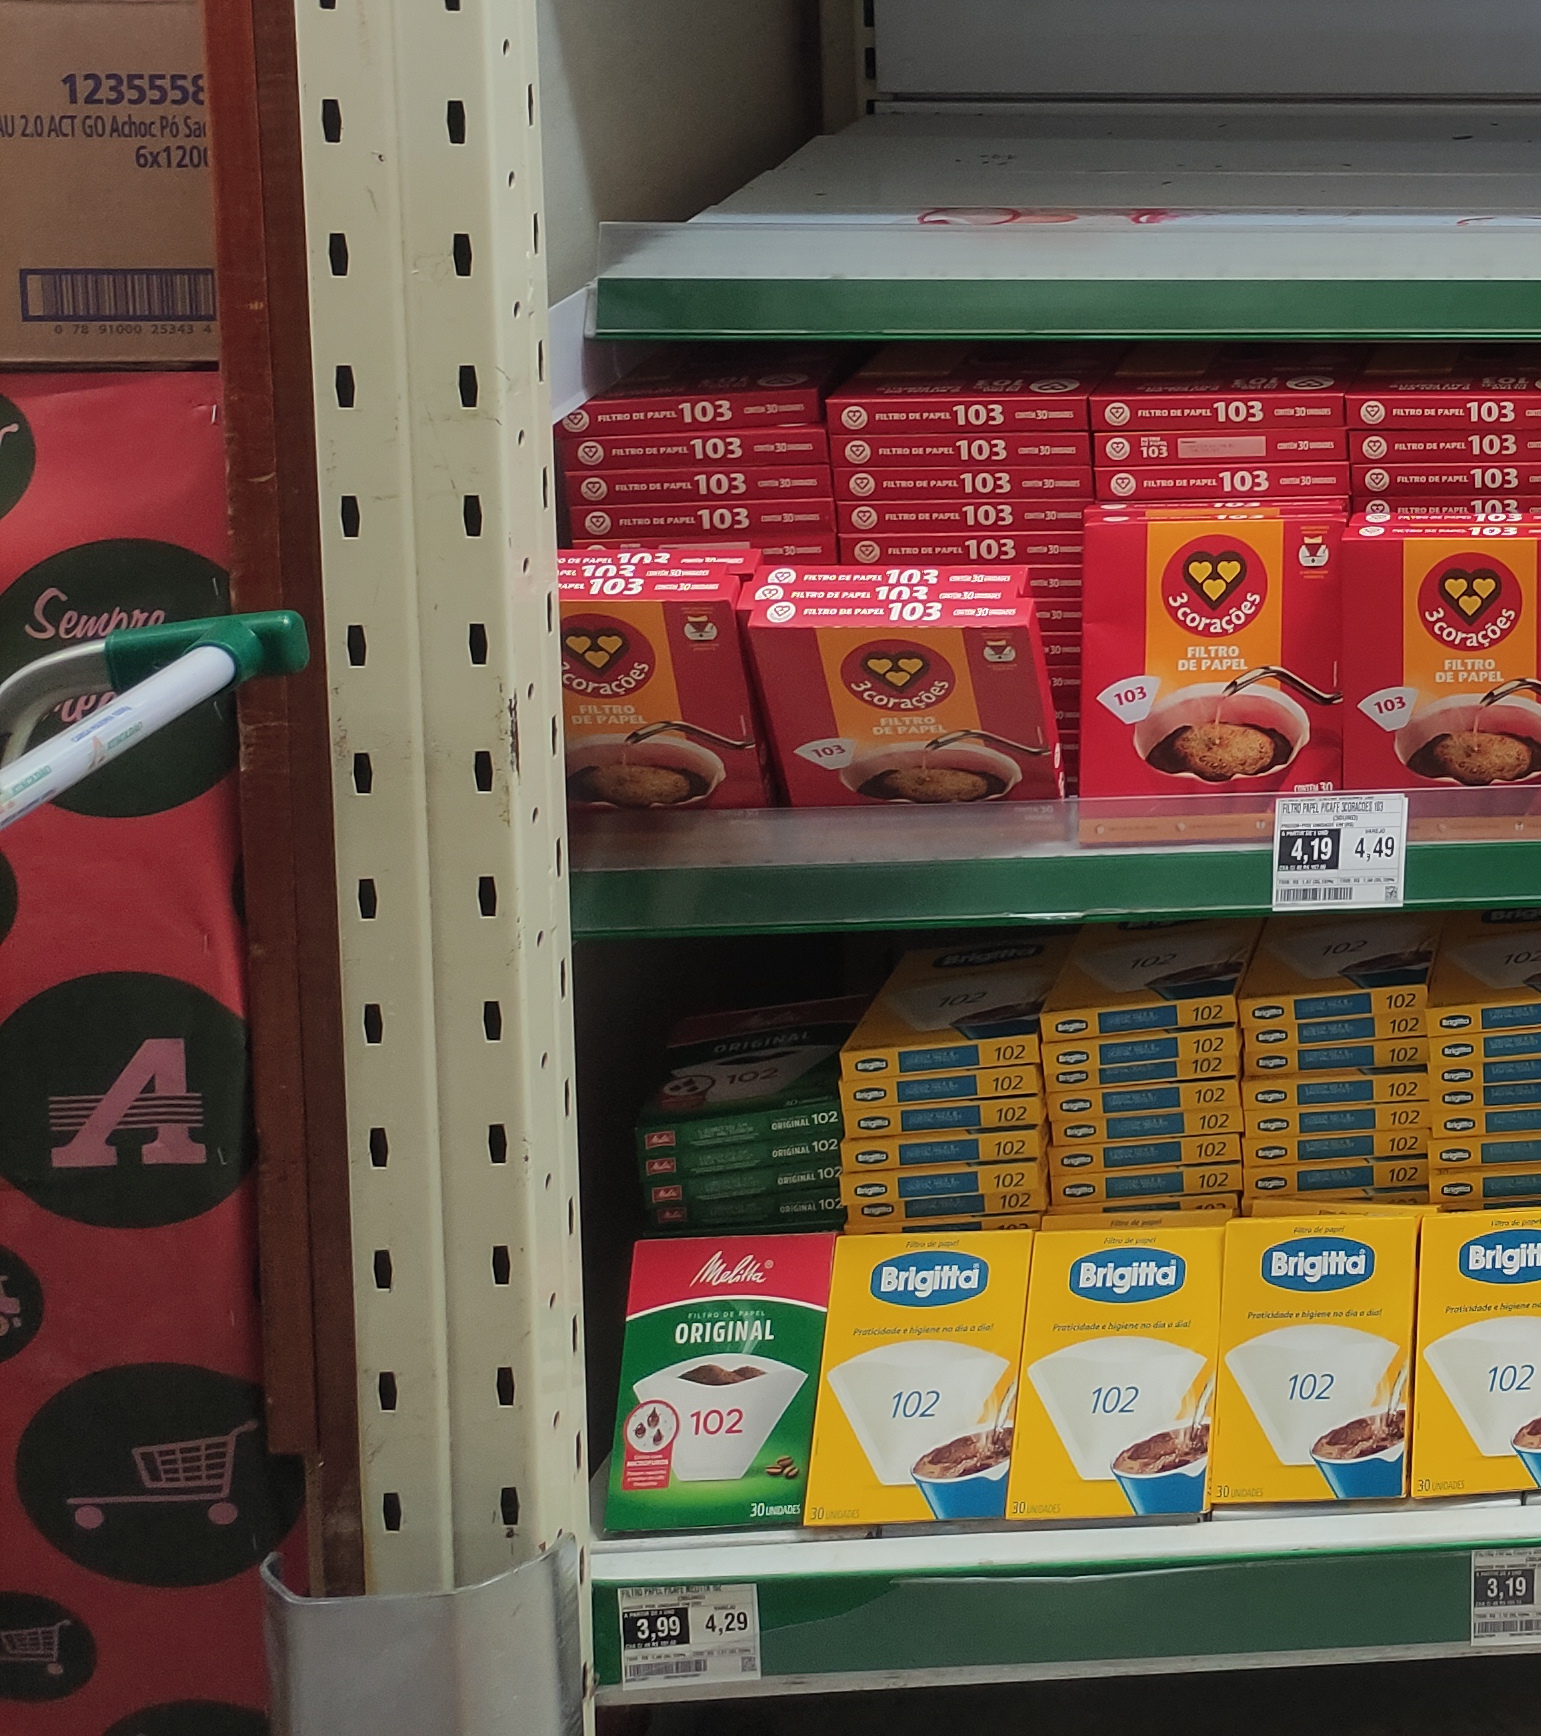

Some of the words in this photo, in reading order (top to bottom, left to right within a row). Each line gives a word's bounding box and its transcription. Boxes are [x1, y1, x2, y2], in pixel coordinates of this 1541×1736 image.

[21, 115, 44, 137] 2.0
[48, 115, 77, 137] ACT
[82, 115, 104, 137] GO
[110, 115, 156, 138] Achoc
[160, 115, 179, 138] Pó
[875, 411, 904, 421] FILTRO
[906, 411, 918, 420] DE
[921, 410, 951, 420] PAPEL
[952, 404, 1004, 426] 103
[1169, 592, 1188, 607] 3
[1183, 590, 1260, 633] corações
[1178, 658, 1200, 671] DE
[1204, 658, 1247, 671] PAPEL
[1187, 645, 1239, 659] FILTRO
[1113, 686, 1147, 707] 103
[1291, 837, 1332, 863] 4,19
[1355, 836, 1395, 862] 4,49
[691, 1253, 766, 1288] Melitta
[880, 1262, 980, 1295] Brigitta
[675, 1320, 774, 1345] ORIGINAL
[891, 1390, 941, 1420] 102
[690, 1409, 743, 1436] 102
[1486, 1576, 1527, 1599] 3,19
[636, 1616, 681, 1642] 3,99
[705, 1610, 748, 1635] 4,29
